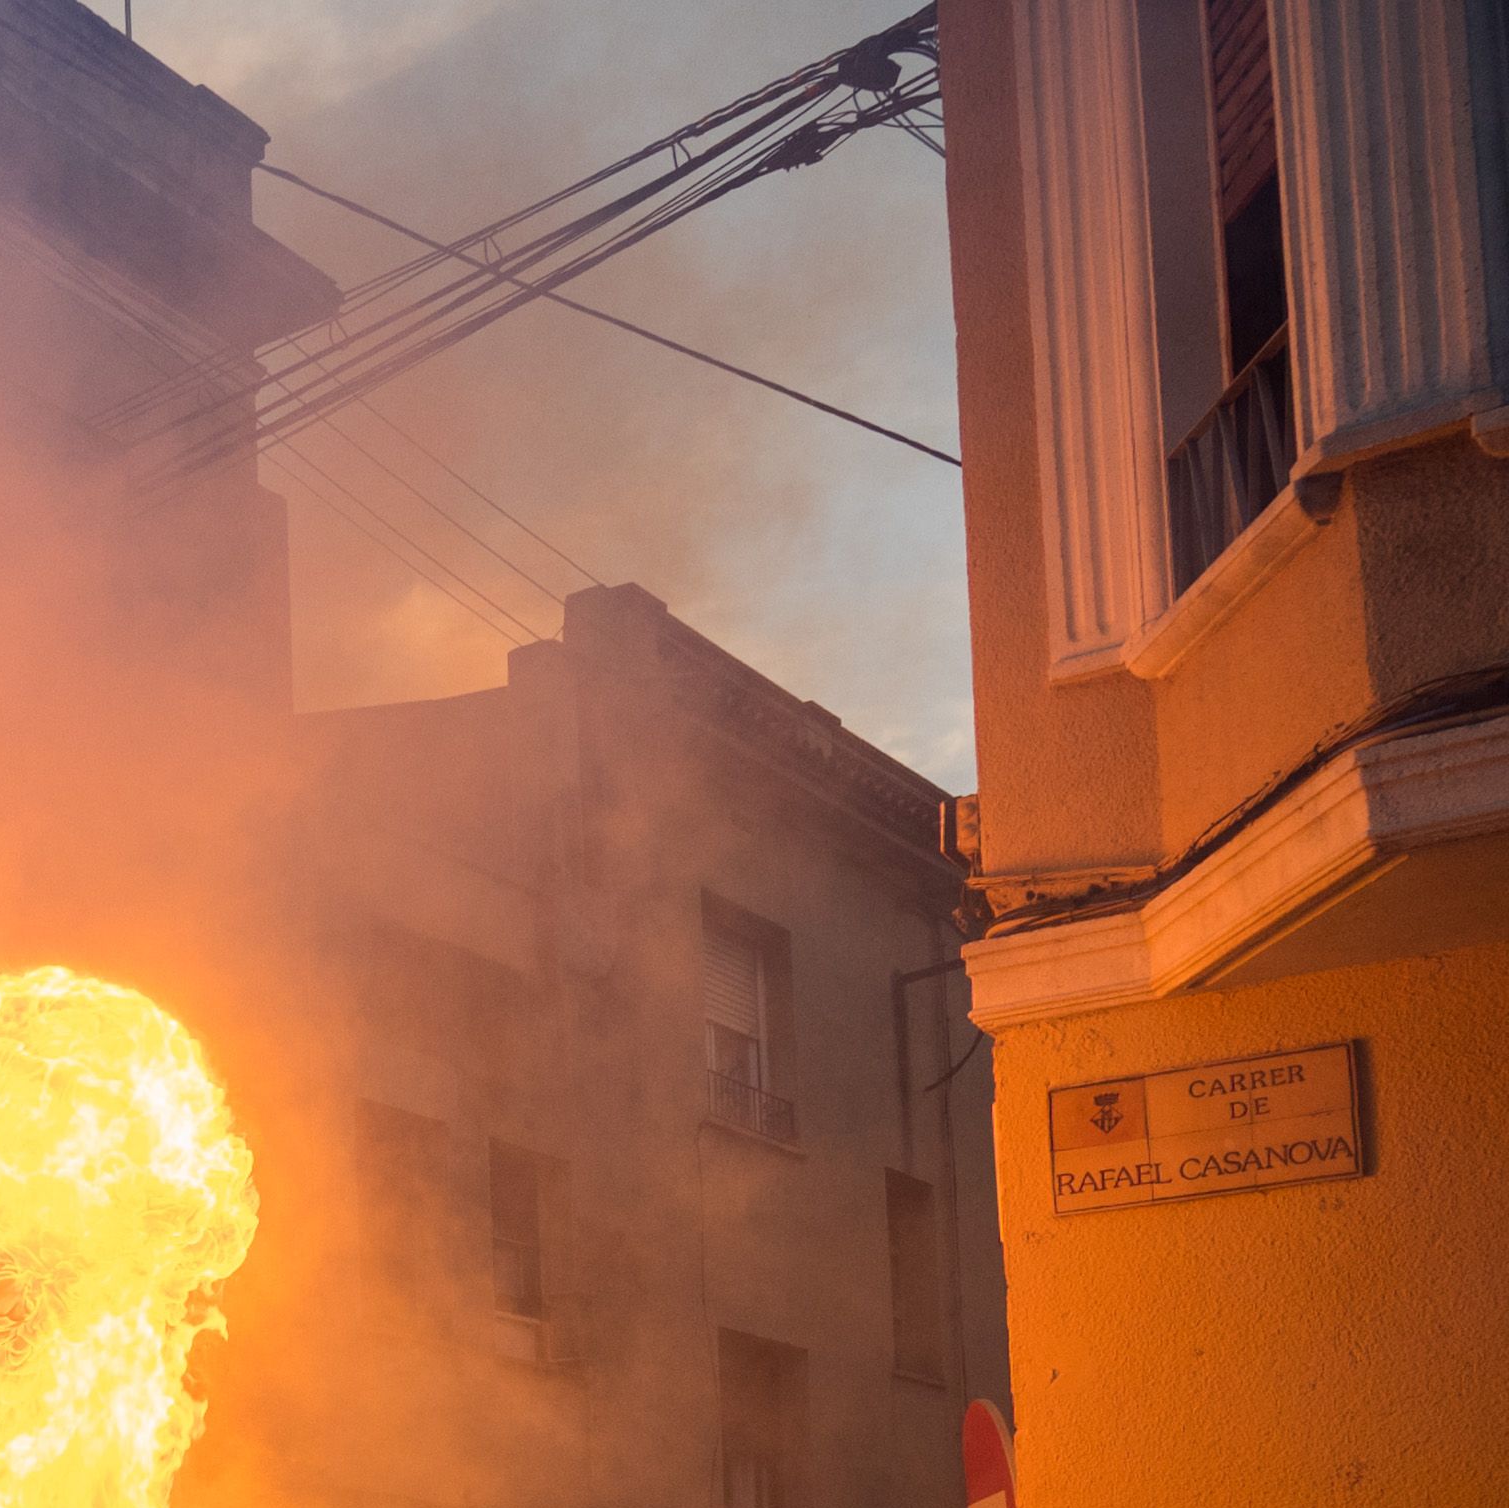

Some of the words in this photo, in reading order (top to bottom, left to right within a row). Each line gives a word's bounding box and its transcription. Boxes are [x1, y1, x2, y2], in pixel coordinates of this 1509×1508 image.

[1188, 1064, 1306, 1099] CARRER
[1229, 1097, 1271, 1120] DE
[1056, 1162, 1173, 1197] RAFAEL
[1179, 1135, 1354, 1182] CASANOVA
